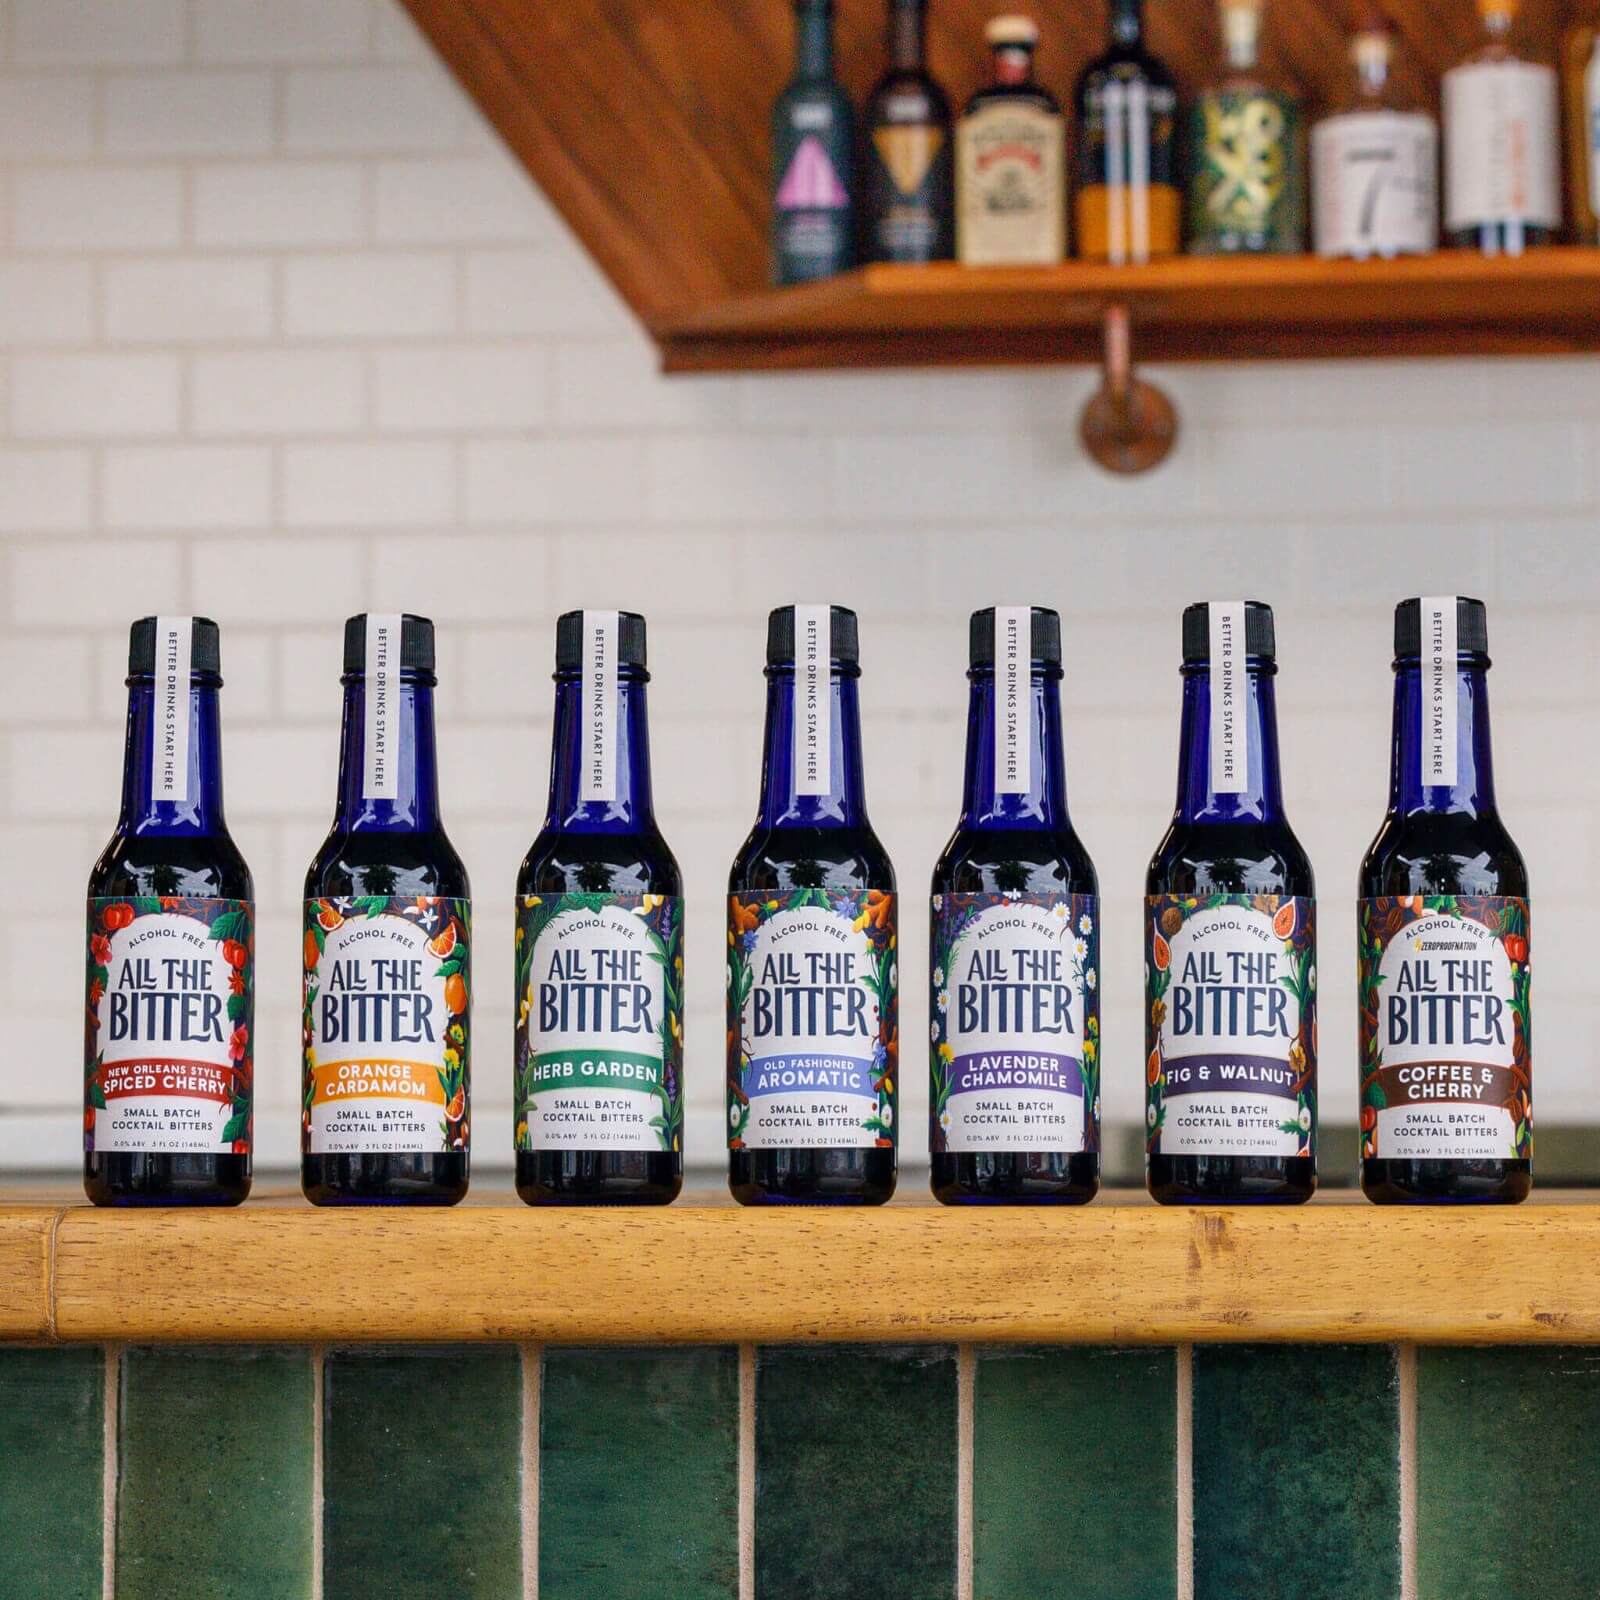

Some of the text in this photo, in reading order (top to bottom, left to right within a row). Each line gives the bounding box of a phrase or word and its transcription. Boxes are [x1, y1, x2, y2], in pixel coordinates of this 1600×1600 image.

[808, 621, 816, 780] BETTER DRINKS START HERE
[1008, 619, 1016, 779] BETTER DRINKS START HERE
[1222, 617, 1233, 778] BETTER DRINKS START HERE
[1433, 612, 1442, 774] BETTER DRINKS START HERE
[164, 632, 177, 789] BETTER DRINKS START HERE
[375, 629, 387, 786] BETTER DRINKS START HERE
[594, 629, 604, 788] BETTER DRINKS START HERE
[129, 929, 205, 949] ALCOHOL FREE
[558, 920, 634, 940] ALCOHOL FREE
[771, 923, 847, 944] ALCOHOL FREE
[978, 919, 1054, 940] ALCOHOL FREE
[1192, 922, 1270, 942] ALCOHOL FREE
[1405, 920, 1484, 940] ALCOHOL FREE
[339, 930, 414, 950] ALCOHOL FREE
[118, 959, 212, 990] ALL THE
[548, 949, 641, 981] ALL THE
[761, 953, 855, 985] ALL THE
[967, 950, 1062, 981] ALL THE
[1182, 952, 1277, 984] ALL THE
[329, 960, 422, 991] ALL THE
[1397, 960, 1492, 992] ALL THE
[110, 992, 224, 1042] BITTER
[540, 983, 654, 1033] BITTER
[753, 987, 868, 1037] BITTER
[958, 984, 1075, 1034] BITTER
[1173, 986, 1290, 1037] BITTER
[322, 994, 435, 1043] BITTER
[1388, 995, 1505, 1045] BITTER
[109, 1065, 222, 1080] NEW ORLEANS STYLE
[338, 1066, 411, 1079] ORANGE
[534, 1061, 656, 1082] HERB GARDEN
[764, 1059, 854, 1070] OLD FASHIONED
[970, 1056, 1058, 1072] LAVENDER
[1398, 1065, 1493, 1083] COFFEE &
[104, 1075, 226, 1095] SPICED CHERRY
[759, 1071, 860, 1088] AROMATIC
[962, 1071, 1066, 1088] CHAMOMILE
[1167, 1066, 1292, 1085] FIG & WALNUT
[326, 1079, 425, 1096] CARDAMOM
[1409, 1083, 1484, 1099] CHERRY
[124, 1108, 200, 1117] SMALL BATCH
[555, 1100, 631, 1109] SMALL BATCH
[771, 1105, 847, 1114] SMALL BATCH
[976, 1102, 1053, 1110] SMALL BATCH
[1189, 1105, 1267, 1114] SMALL BATCH
[337, 1111, 412, 1119] SMALL BATCH
[543, 1113, 643, 1122] COCKTAIL BITTERS
[759, 1118, 860, 1127] COCKTAIL BITTERS
[964, 1115, 1065, 1124] COCKTAIL BITTERS
[1177, 1118, 1280, 1128] COCKTAIL BITTERS
[1406, 1115, 1485, 1123] SMALL BATCH
[112, 1121, 212, 1130] COCKTAIL BITTERS
[326, 1124, 376, 1132] COCKTAIL
[1394, 1128, 1497, 1136] COCKTAIL BITTERS
[1198, 1138, 1213, 1146] ABV
[1226, 1138, 1234, 1146] FL
[1236, 1138, 1247, 1146] OZ
